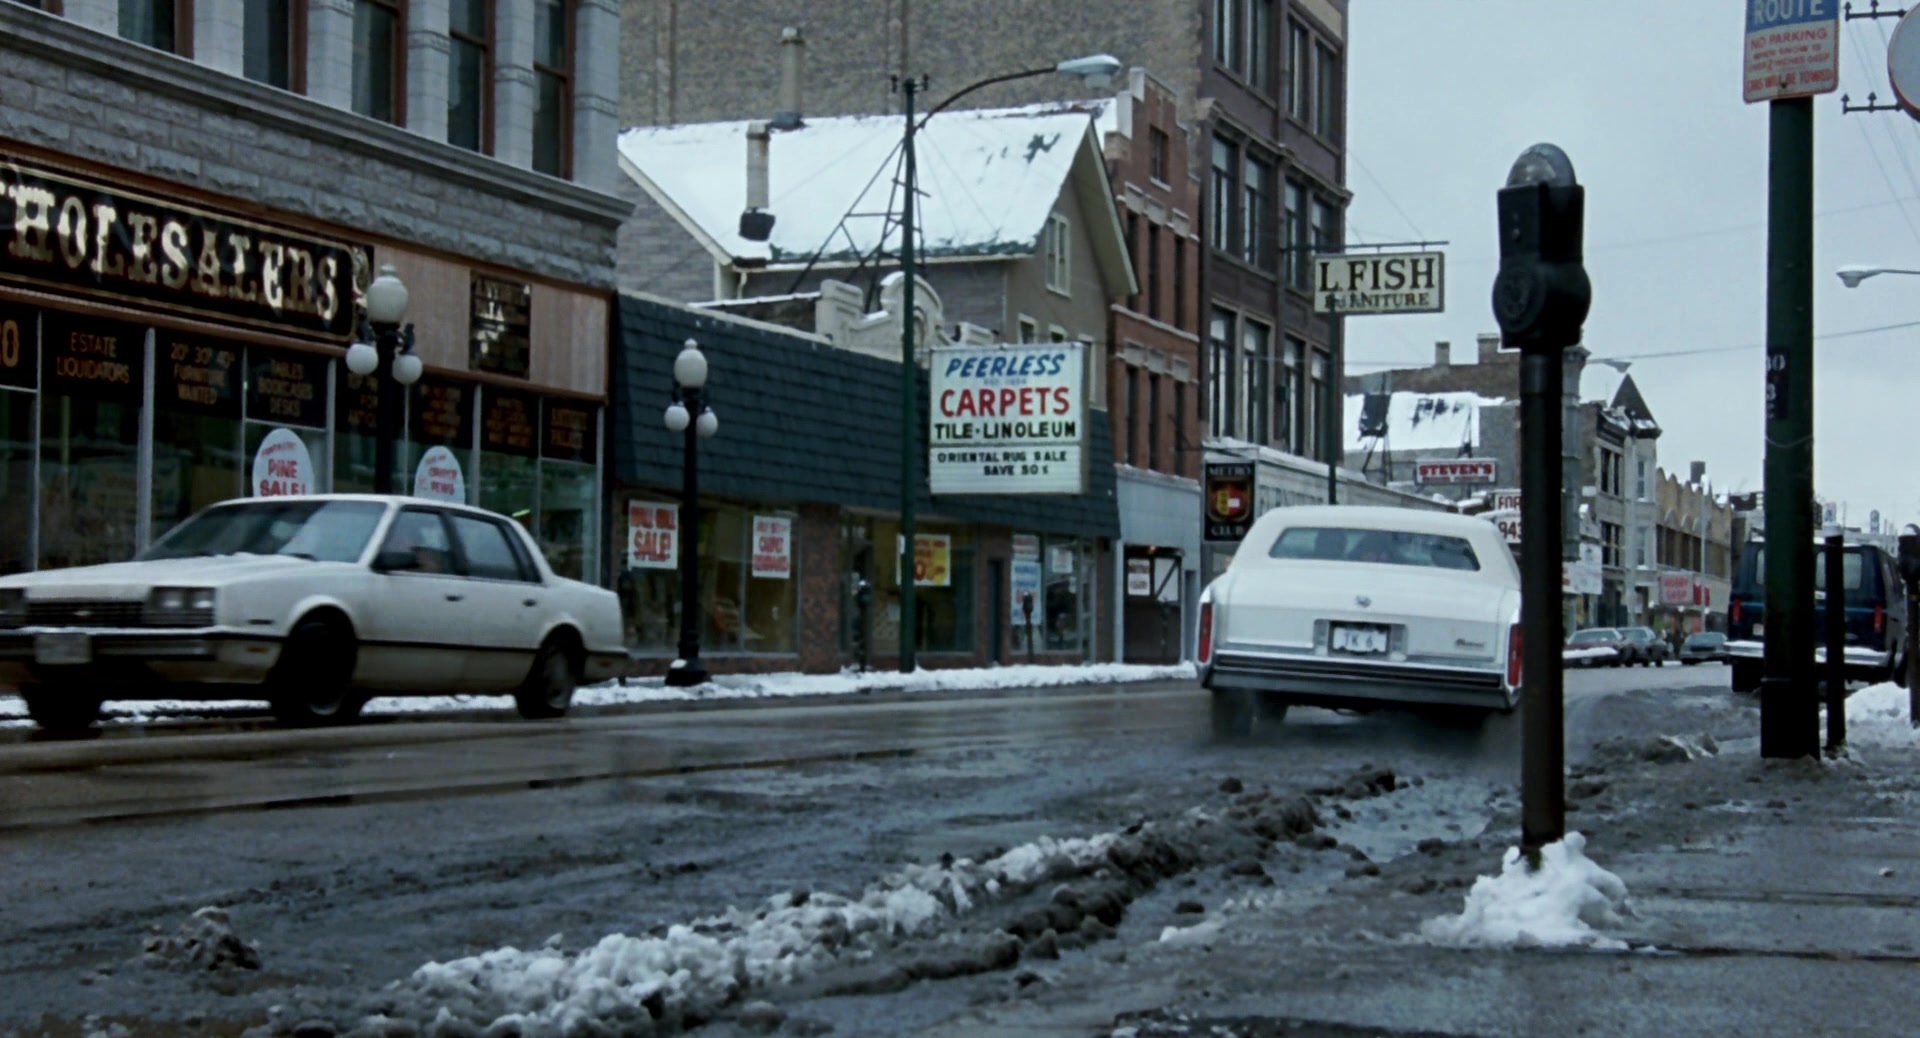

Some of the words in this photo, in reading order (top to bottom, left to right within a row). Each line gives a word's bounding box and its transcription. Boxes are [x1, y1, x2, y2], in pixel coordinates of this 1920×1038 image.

[1754, 0, 1824, 25] ROUTE
[1751, 37, 1766, 49] NO
[1769, 27, 1828, 44] PARKING
[0, 180, 340, 323] HOLESALERS
[1347, 257, 1436, 291] FISH
[70, 331, 118, 359] ESTATE
[55, 355, 131, 385] LIQUIDATORS
[945, 353, 1066, 379] PEERLESS
[940, 386, 1070, 417] CARPETS
[983, 421, 1076, 440] LINOLEUM
[268, 459, 298, 478] PINE
[937, 452, 999, 463] ORIENTAL
[1003, 451, 1027, 462] RUG
[1034, 451, 1067, 462] SALE
[983, 465, 1015, 476] SAVE
[1419, 463, 1492, 476] STEVEN'S
[1211, 525, 1245, 537] CLUB
